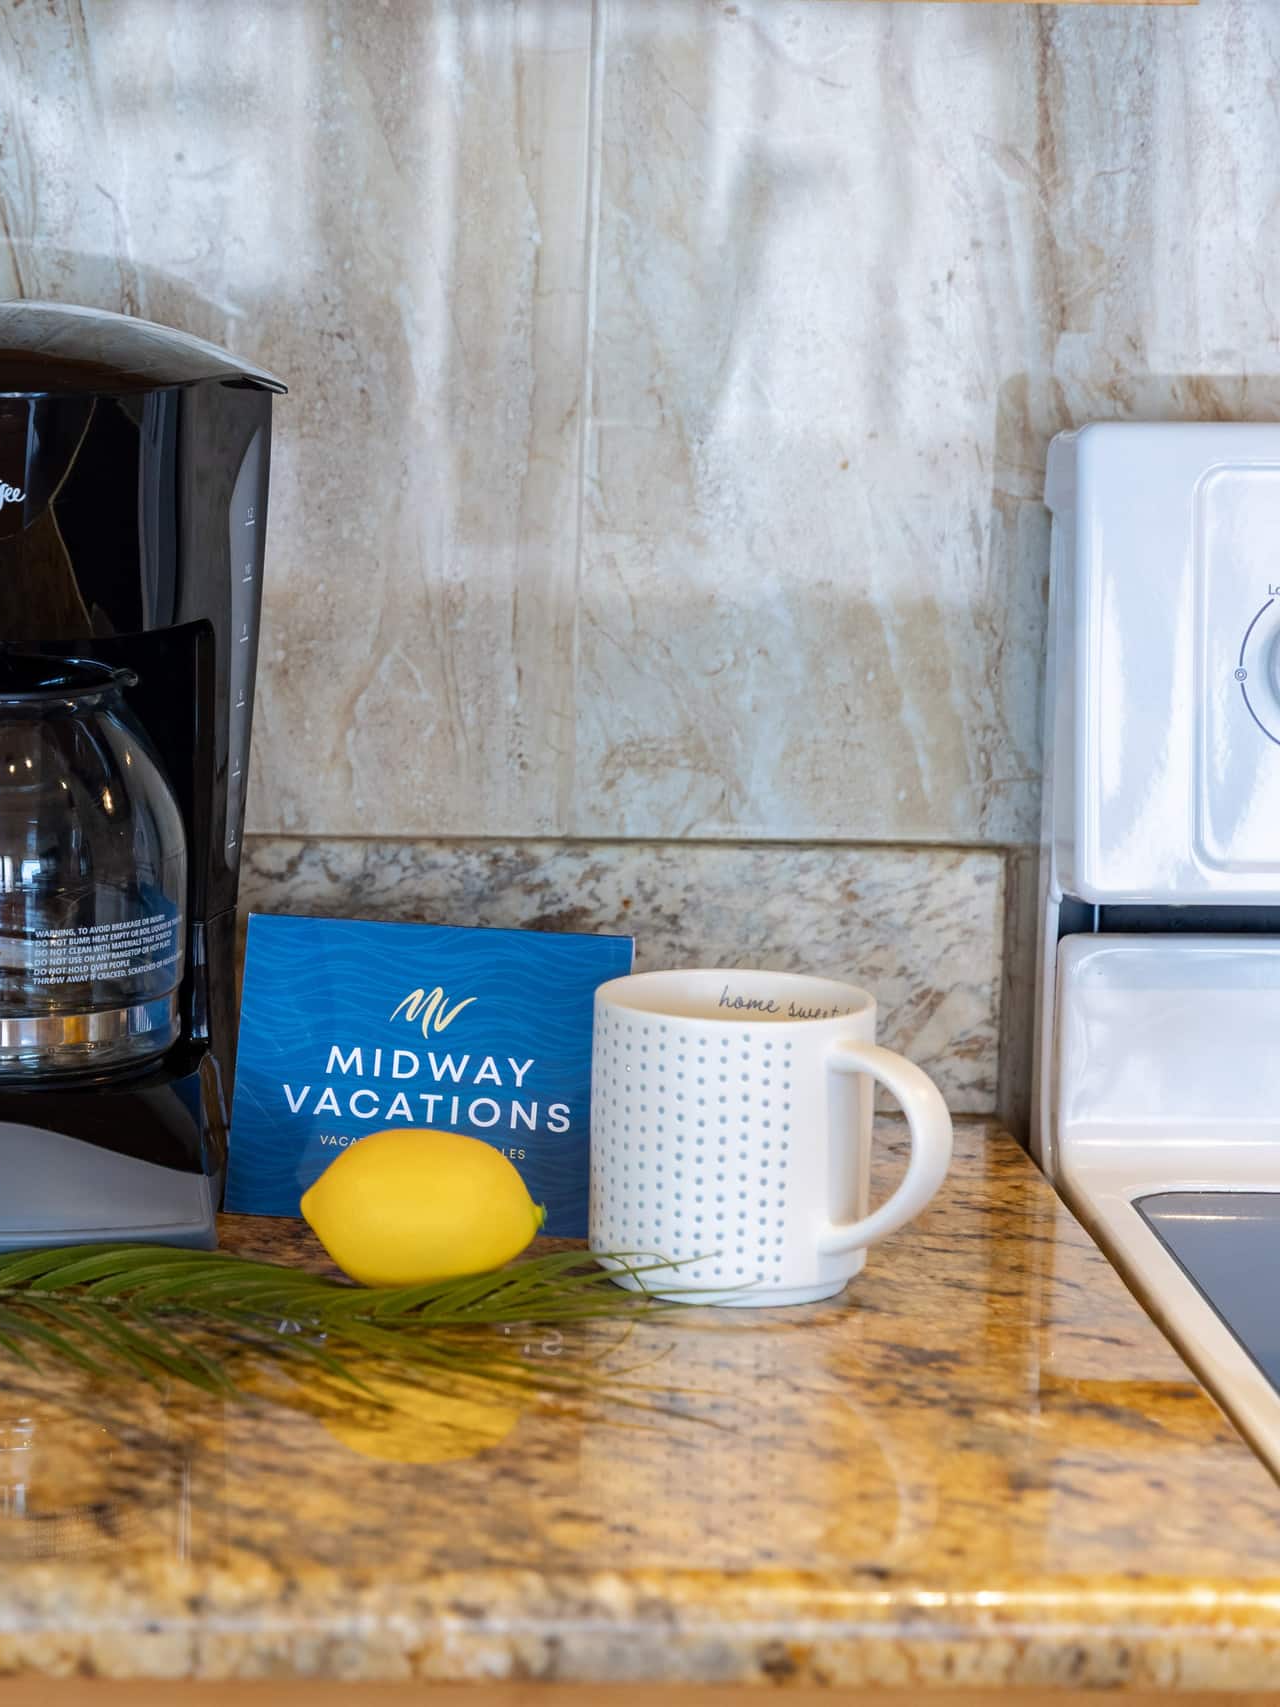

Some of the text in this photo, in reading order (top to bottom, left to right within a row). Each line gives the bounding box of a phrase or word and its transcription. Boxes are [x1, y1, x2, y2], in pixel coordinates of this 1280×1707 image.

[78, 927, 88, 935] TO
[89, 924, 111, 934] AVOID
[112, 919, 141, 931] BREAKAGE
[34, 949, 48, 957] DO
[50, 948, 67, 956] NOT
[69, 946, 92, 955] CLEAN
[93, 943, 111, 953] WITH
[112, 938, 141, 950] MATERIALS
[35, 940, 48, 948] DO
[50, 938, 67, 947] NOT
[92, 934, 109, 943] HEAT
[110, 931, 130, 941] EMPTY
[34, 959, 48, 967] DO
[49, 957, 67, 966] NOT
[69, 956, 83, 964] USE
[84, 954, 95, 963] ON
[96, 952, 110, 961] ANY
[111, 948, 141, 959] RANGETOP
[34, 959, 130, 976] DO NOT HOLD OVER PEOPLE
[32, 976, 65, 985] THROW
[66, 974, 89, 983] AWAY
[90, 972, 97, 981] IF
[718, 985, 780, 1014] home
[325, 1045, 535, 1088] MIDWAY
[283, 1084, 571, 1133] VACATIONS
[320, 1135, 525, 1160] VACA LES
